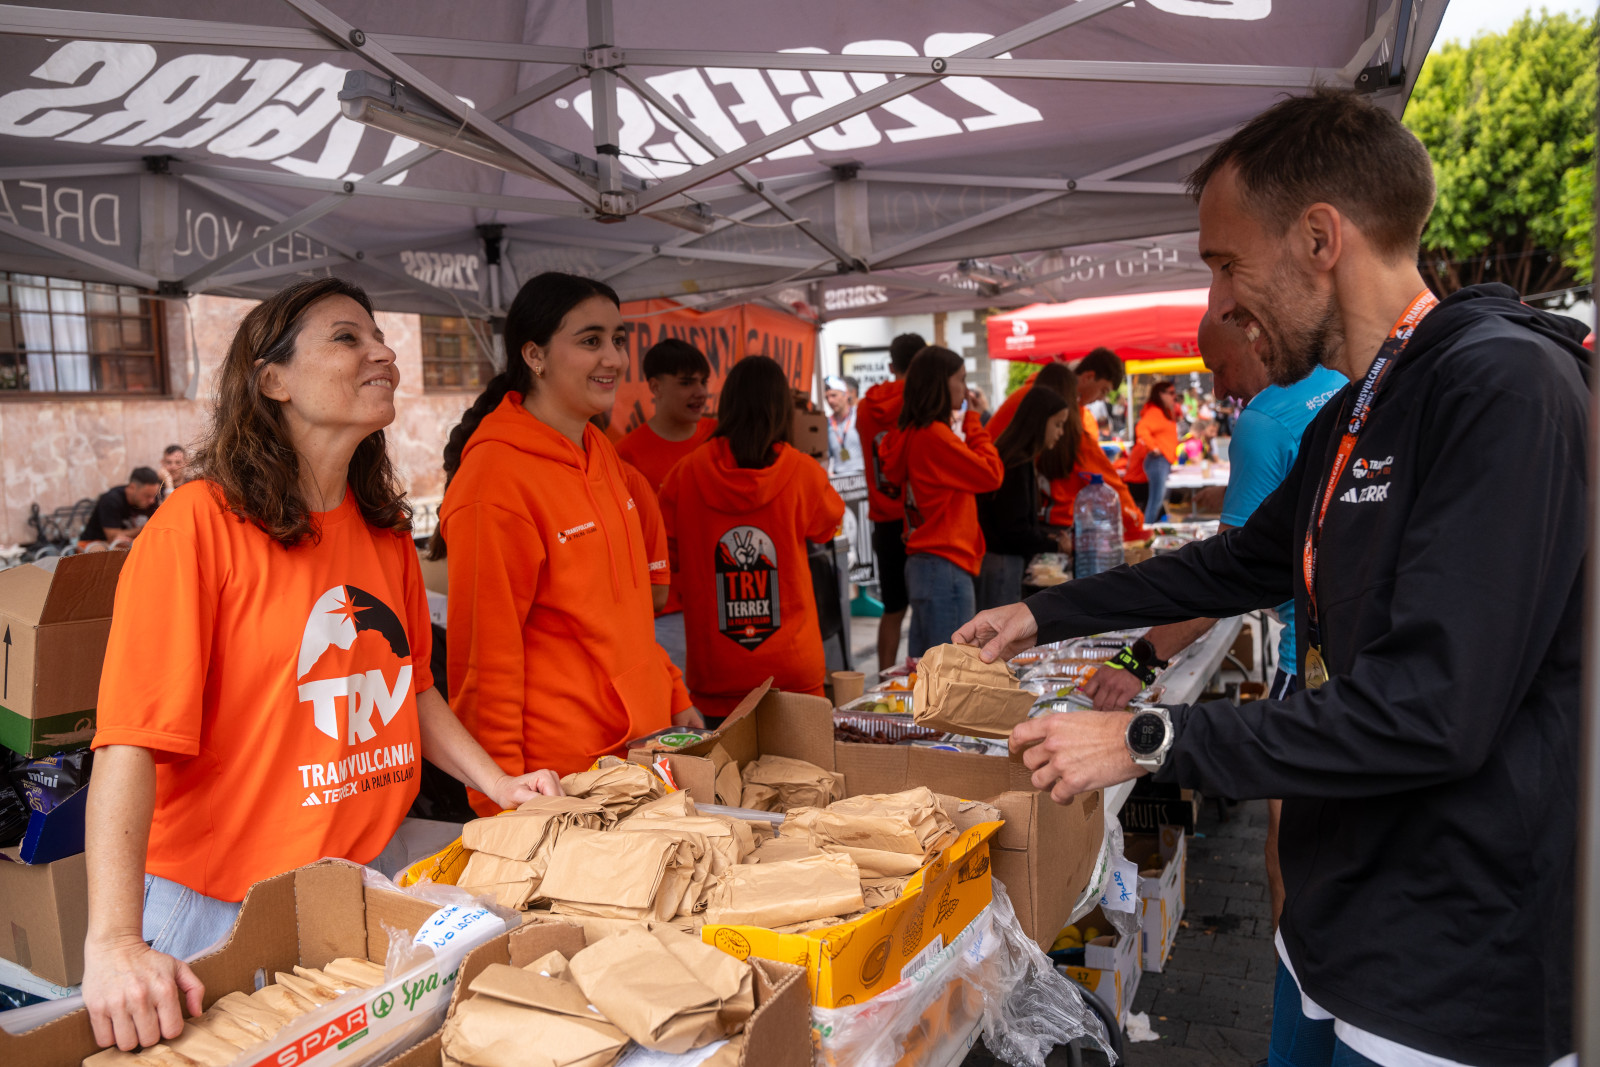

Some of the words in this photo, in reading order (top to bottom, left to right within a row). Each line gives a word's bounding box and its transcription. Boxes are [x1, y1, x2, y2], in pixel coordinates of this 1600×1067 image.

[1352, 357, 1387, 418] TRANSVULCANIA
[725, 570, 768, 600] TRV
[727, 599, 770, 618] TERREX
[297, 664, 413, 746] TRV
[28, 771, 59, 788] mini
[361, 778, 371, 792] LA
[277, 1009, 366, 1067] SPAR
